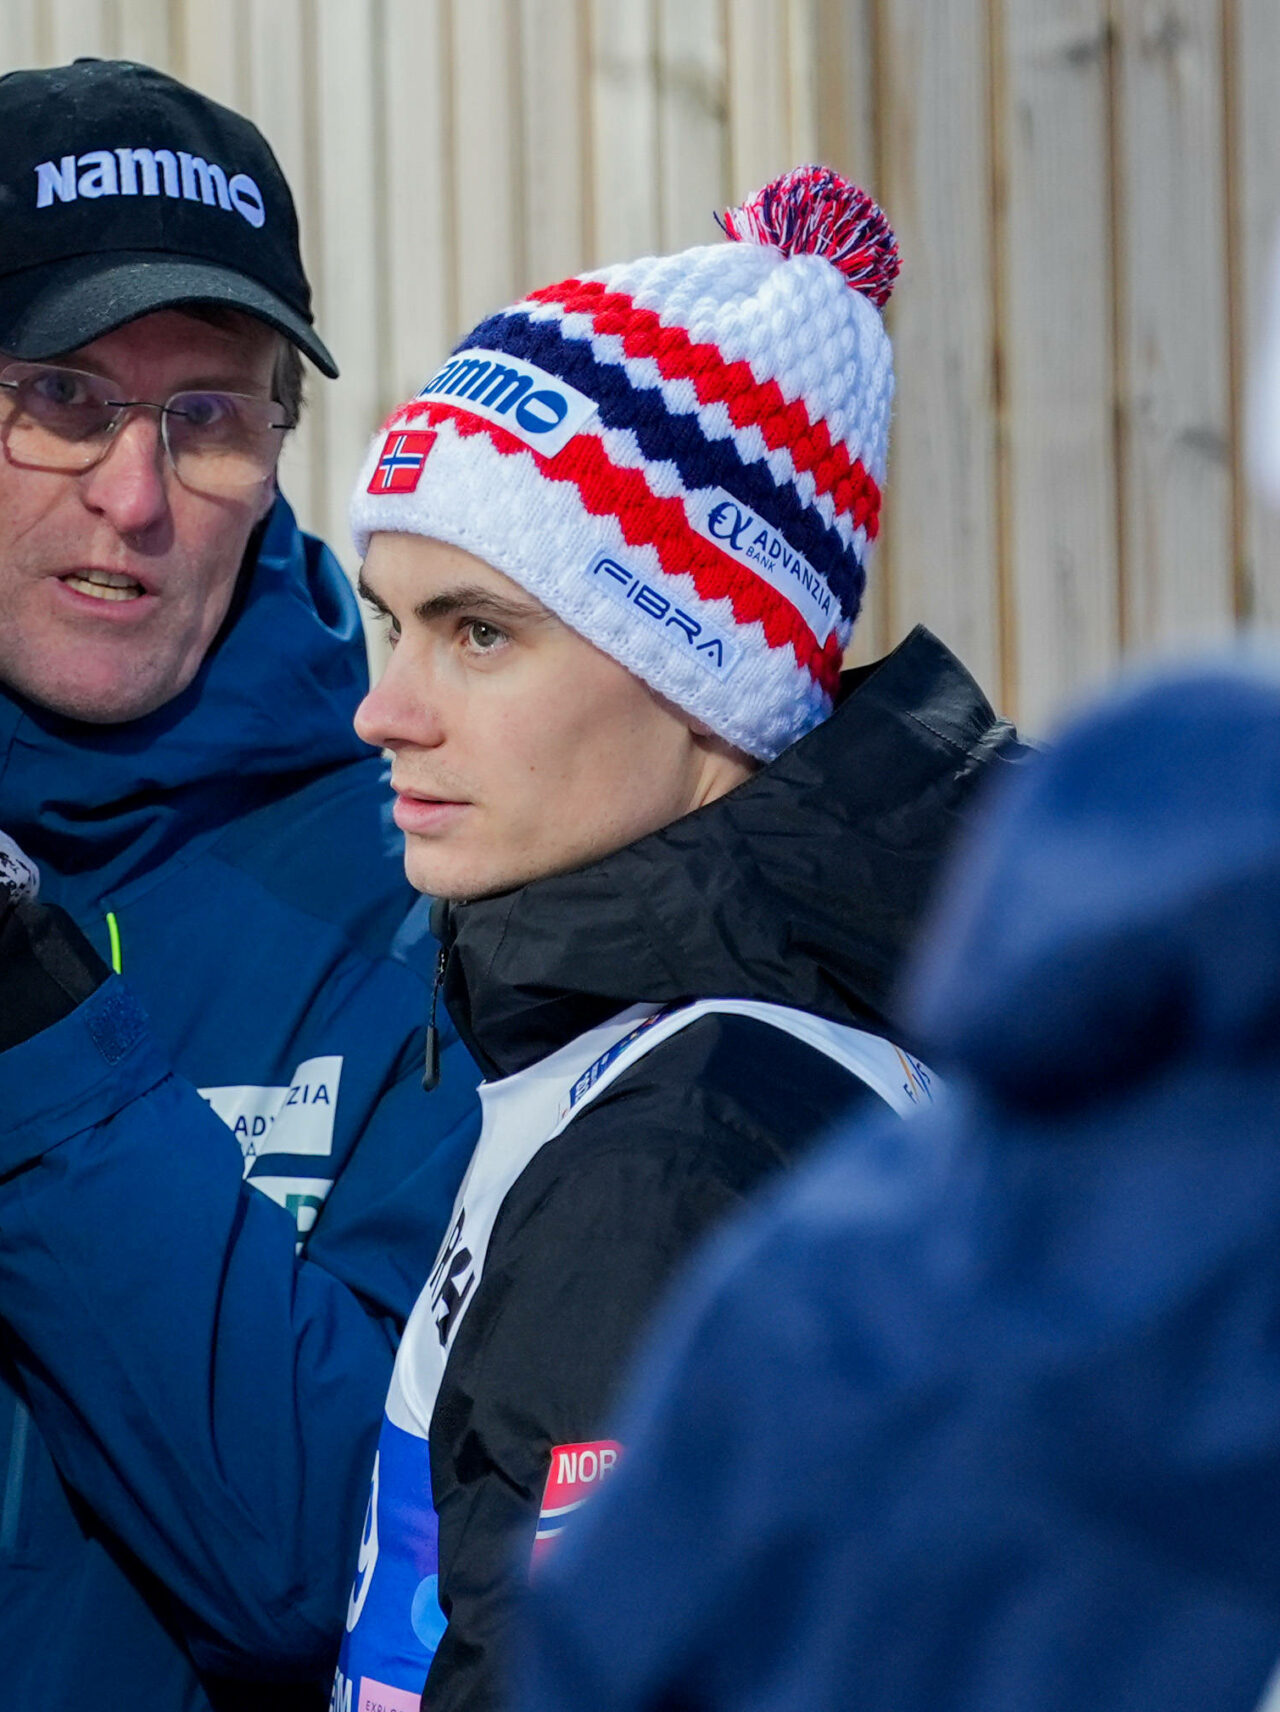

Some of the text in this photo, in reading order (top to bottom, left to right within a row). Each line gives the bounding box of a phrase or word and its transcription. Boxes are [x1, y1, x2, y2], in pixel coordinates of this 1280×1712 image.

[34, 148, 266, 228] Nammo
[419, 358, 568, 435] ammo
[746, 546, 776, 573] BANK
[753, 530, 831, 616] ADVANZIA
[594, 559, 723, 667] FIBRA
